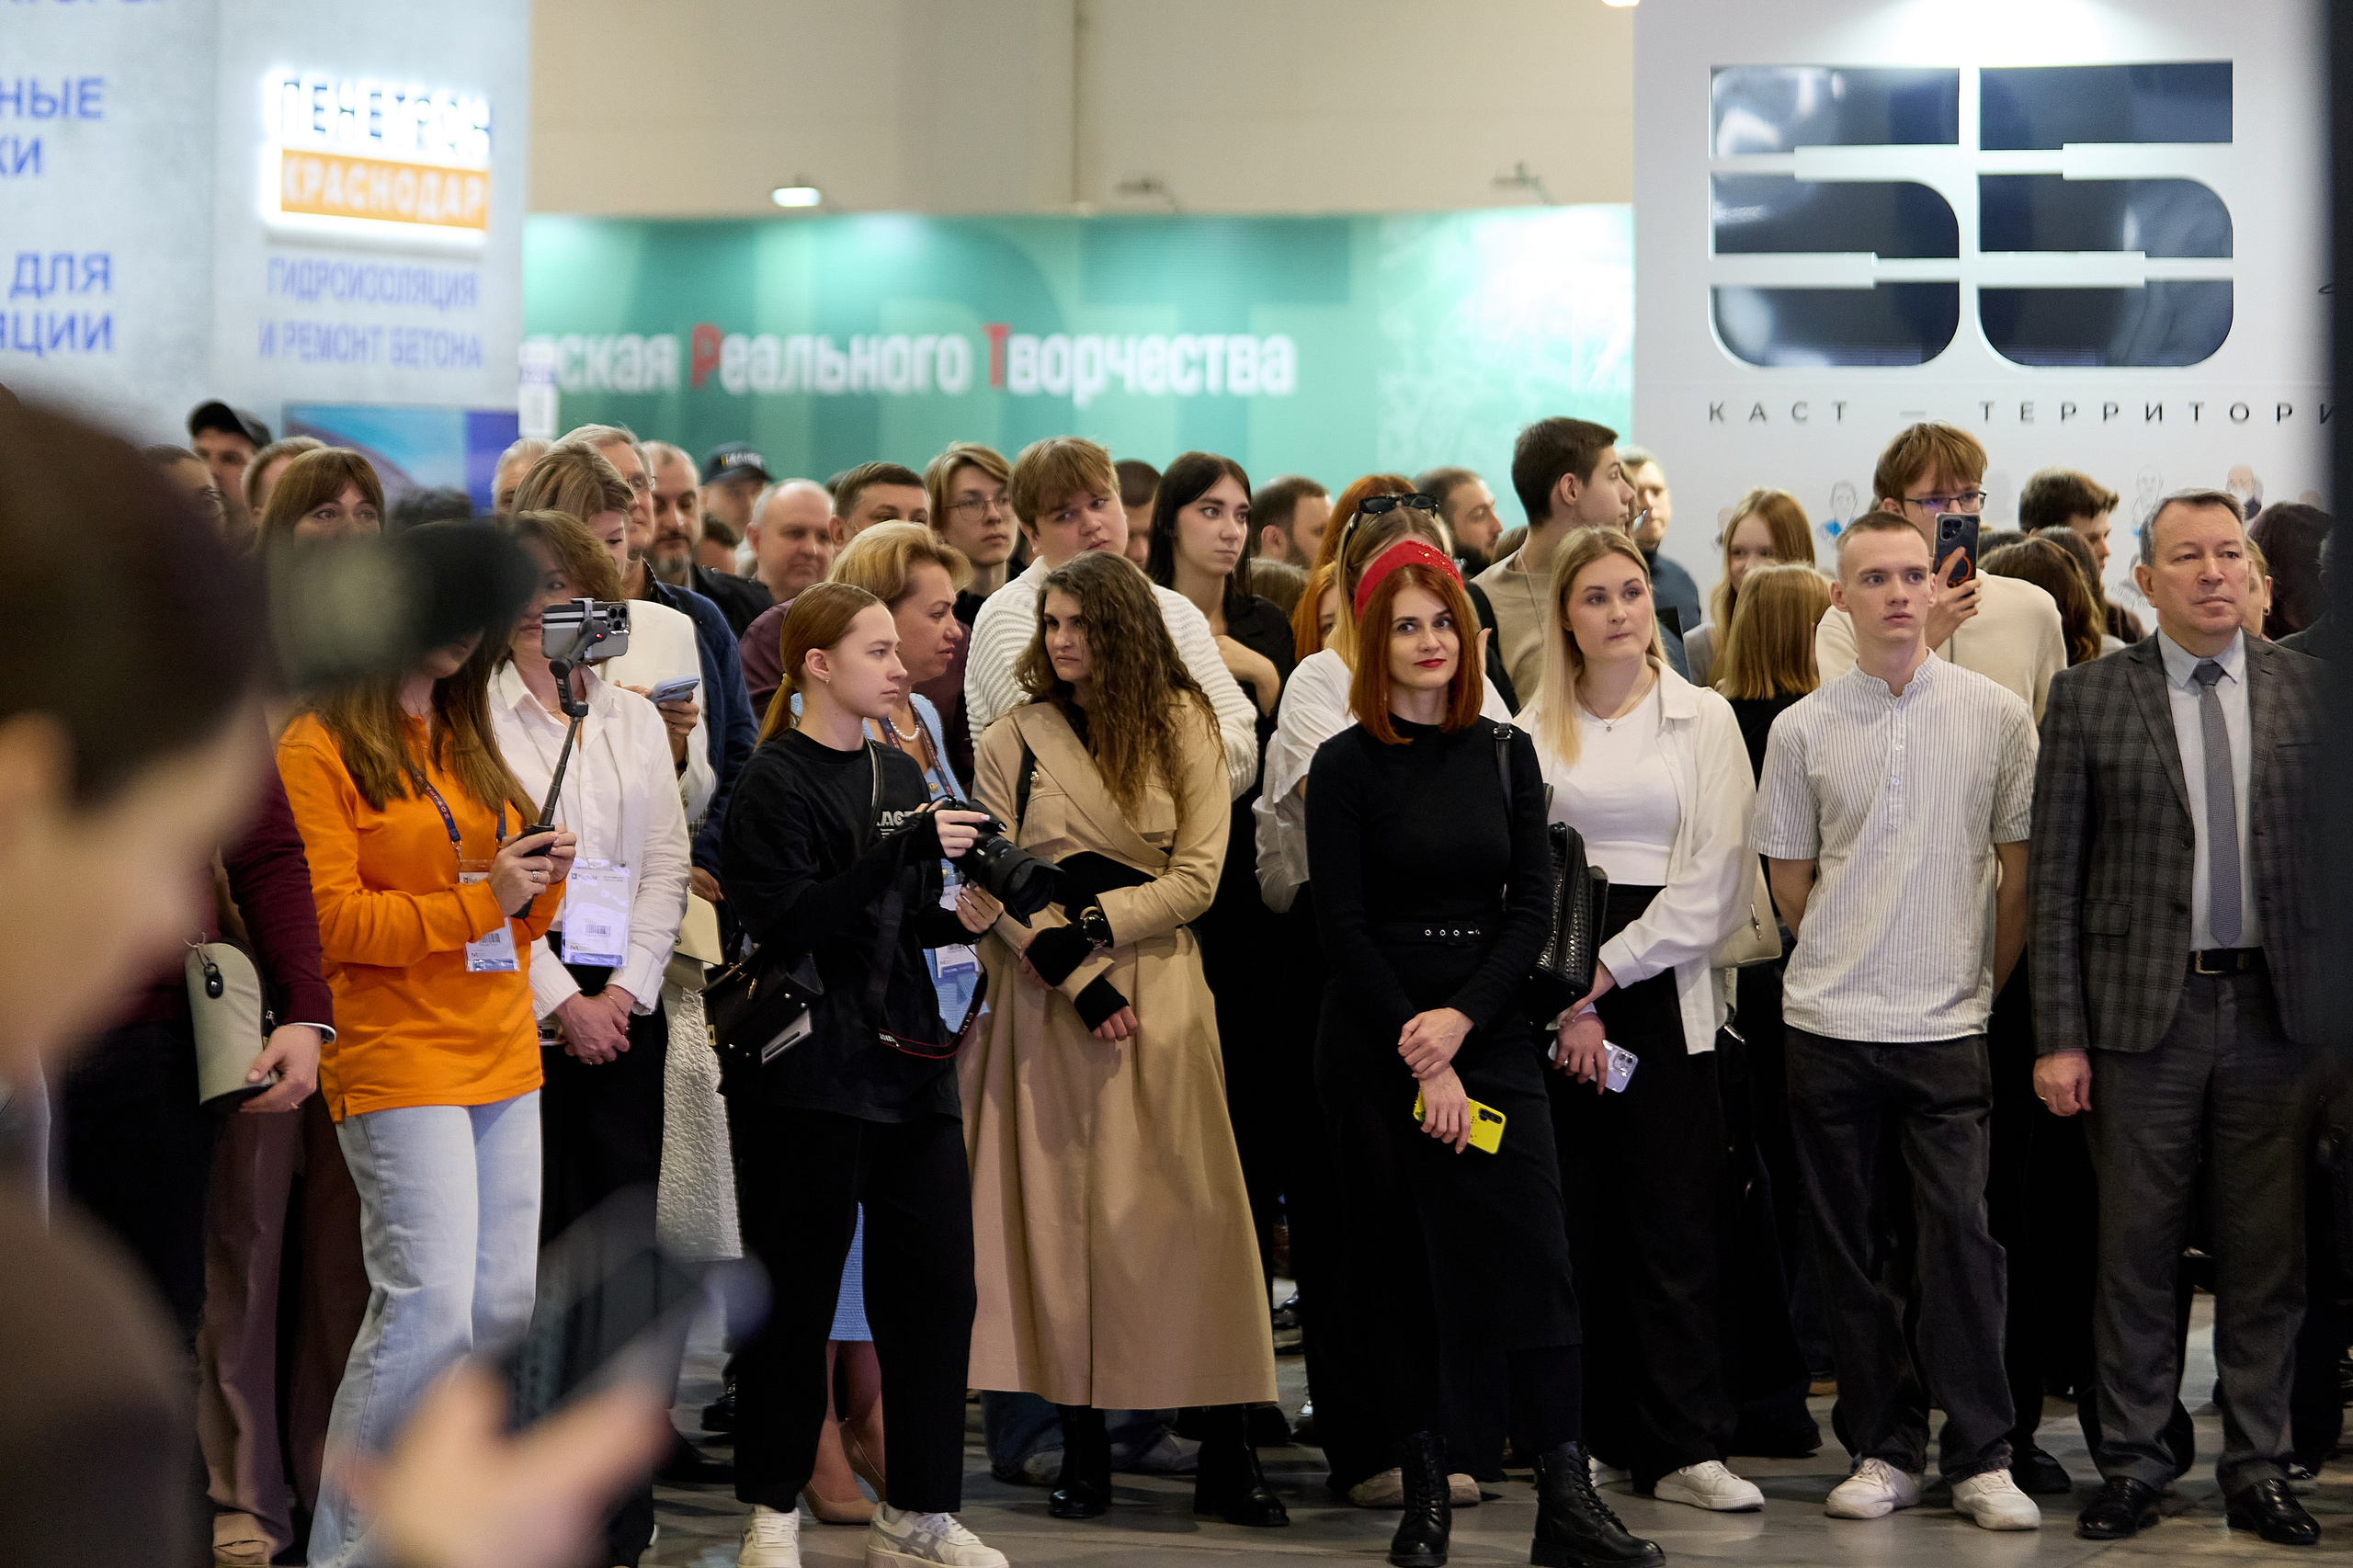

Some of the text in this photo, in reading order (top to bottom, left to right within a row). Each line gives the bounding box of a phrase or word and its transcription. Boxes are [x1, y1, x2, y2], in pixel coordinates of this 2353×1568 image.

[281, 156, 483, 222] КРАСНОДАР
[7, 252, 111, 301] ДЛЯ
[267, 256, 478, 311] ГИДРОИЗОЛЯЦИЯ
[258, 321, 484, 369] И РЕМОНТ БЕТОНА
[690, 324, 972, 396] Реального
[983, 323, 1299, 410] Творчества
[1709, 401, 1847, 424] КАСТ
